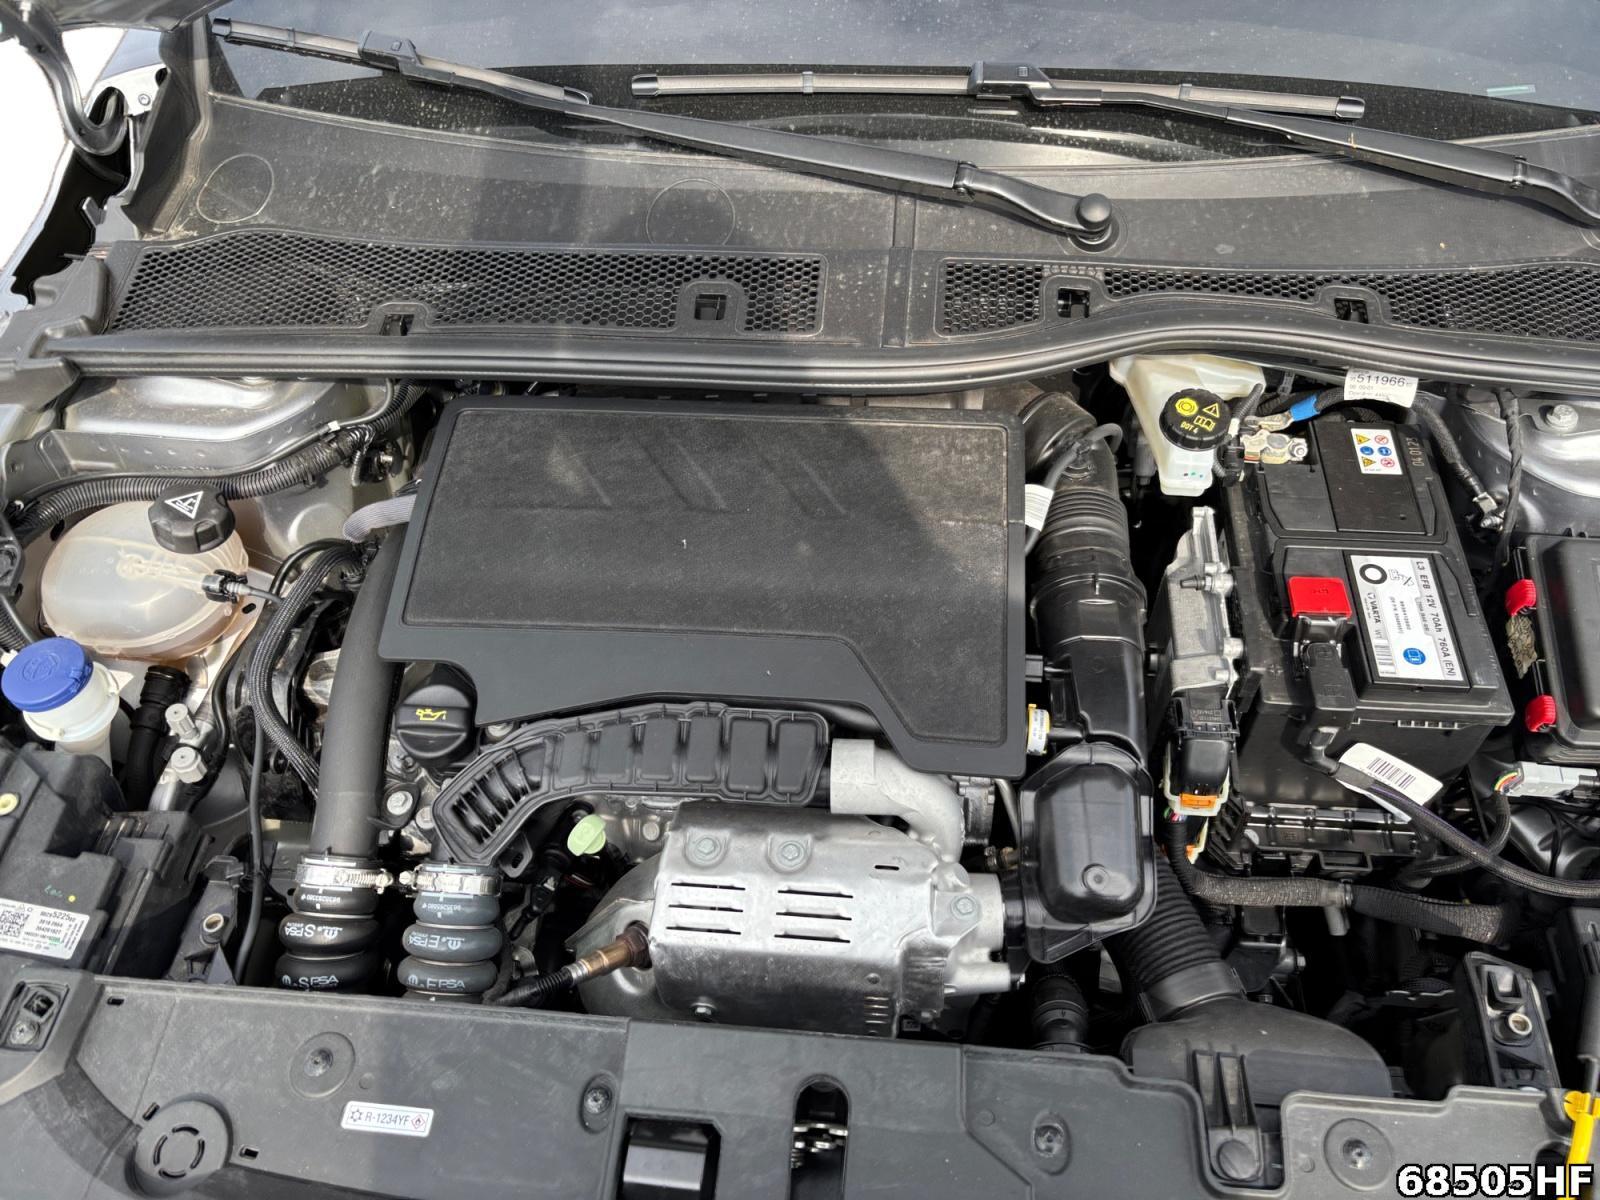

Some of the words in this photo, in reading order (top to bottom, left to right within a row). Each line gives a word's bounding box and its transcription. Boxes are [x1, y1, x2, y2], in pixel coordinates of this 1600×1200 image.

[1180, 421, 1194, 431] DOT
[1416, 561, 1425, 570] L3
[1419, 574, 1431, 589] EFB
[1425, 594, 1437, 608] 12V
[1370, 601, 1381, 624] VARTA
[1431, 612, 1443, 632] 70Ah
[1438, 637, 1450, 658] 760A
[1443, 659, 1456, 676] (EN)
[284, 926, 304, 937] PSA
[310, 975, 338, 986] PSA
[438, 979, 466, 989] PSA
[364, 1111, 412, 1126] R-1234YF
